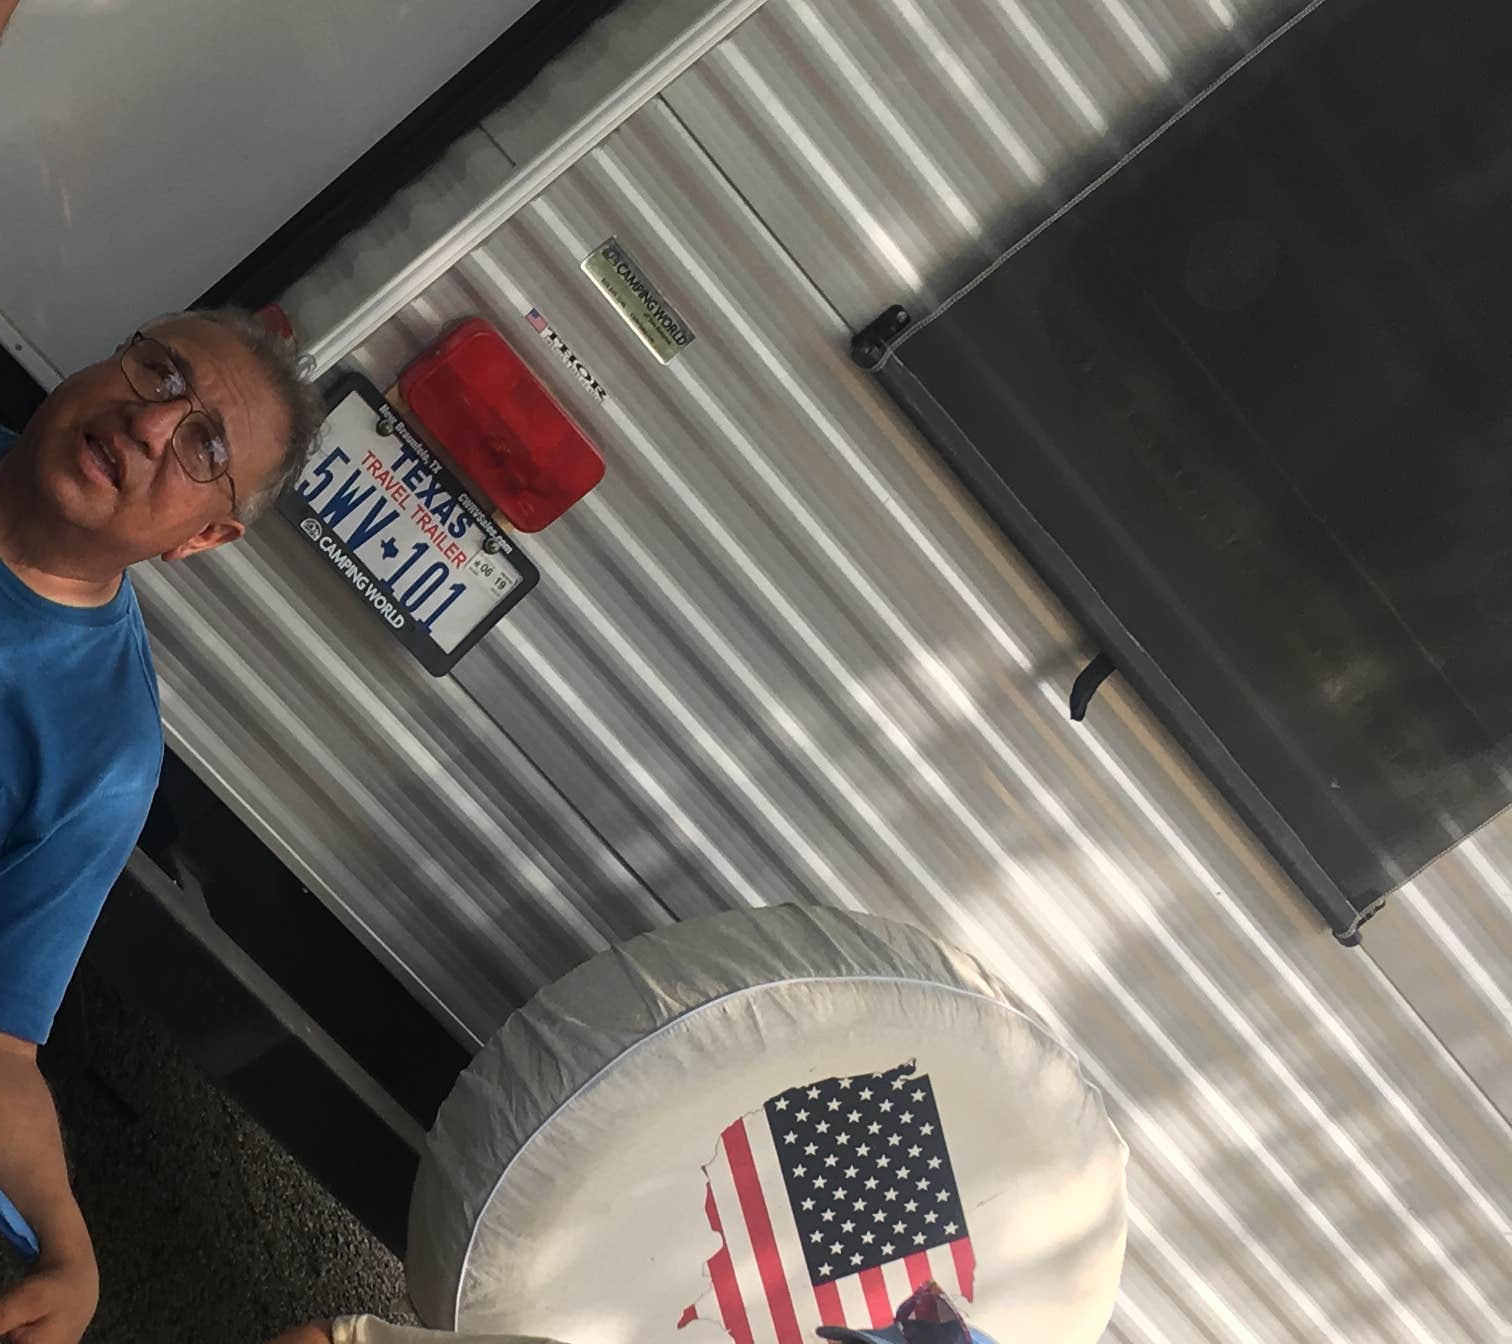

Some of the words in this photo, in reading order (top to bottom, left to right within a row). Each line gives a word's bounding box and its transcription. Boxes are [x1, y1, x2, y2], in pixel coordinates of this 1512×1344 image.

[616, 262, 660, 313] CAMPING
[652, 305, 689, 347] WORLD
[547, 327, 608, 400] THOR
[360, 450, 409, 511] TRAVEL
[409, 504, 468, 570] TRAILER
[390, 443, 476, 539] TEXAS
[428, 459, 443, 474] TX
[318, 536, 370, 591] CAMPING
[364, 585, 405, 629] WORLD
